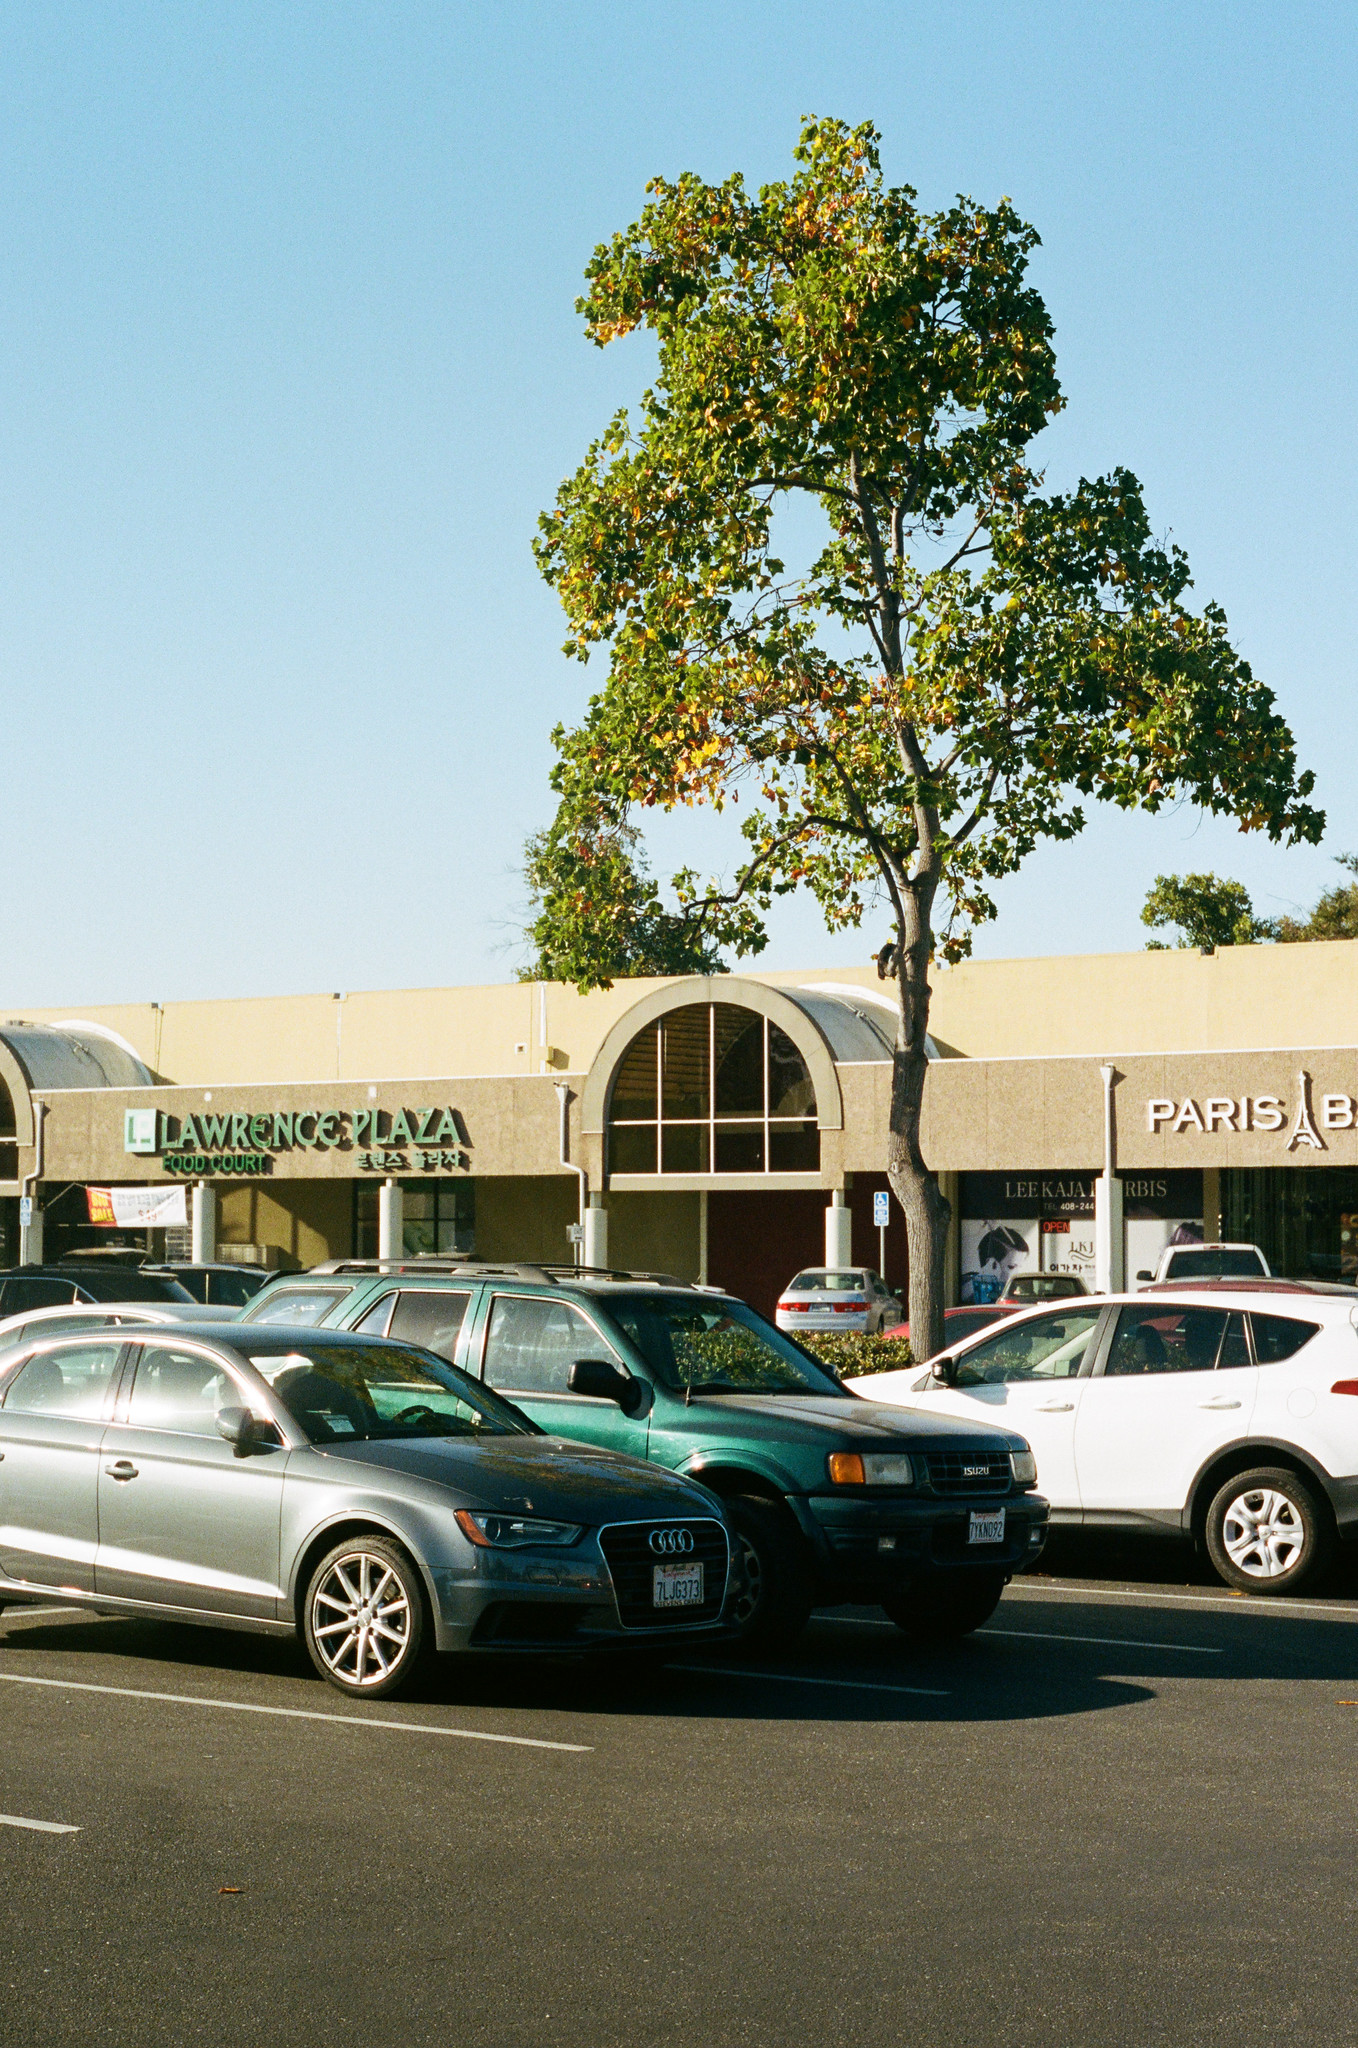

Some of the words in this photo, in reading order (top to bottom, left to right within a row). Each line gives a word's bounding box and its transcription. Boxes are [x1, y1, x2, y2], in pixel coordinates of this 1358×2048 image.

[1148, 1095, 1283, 1132] PARIS
[1322, 1094, 1358, 1129] B
[160, 1108, 342, 1149] LAWRENCE
[351, 1106, 462, 1145] PLAZA
[163, 1154, 206, 1172] FOOD
[211, 1153, 266, 1171] COURT
[91, 1208, 115, 1222] SALE
[1043, 1221, 1071, 1233] OPEN
[1071, 1241, 1093, 1253] LKJ
[963, 1466, 990, 1476] ISUZU
[969, 1520, 1004, 1539] 7YKN092
[656, 1579, 700, 1601] 7LJG373
